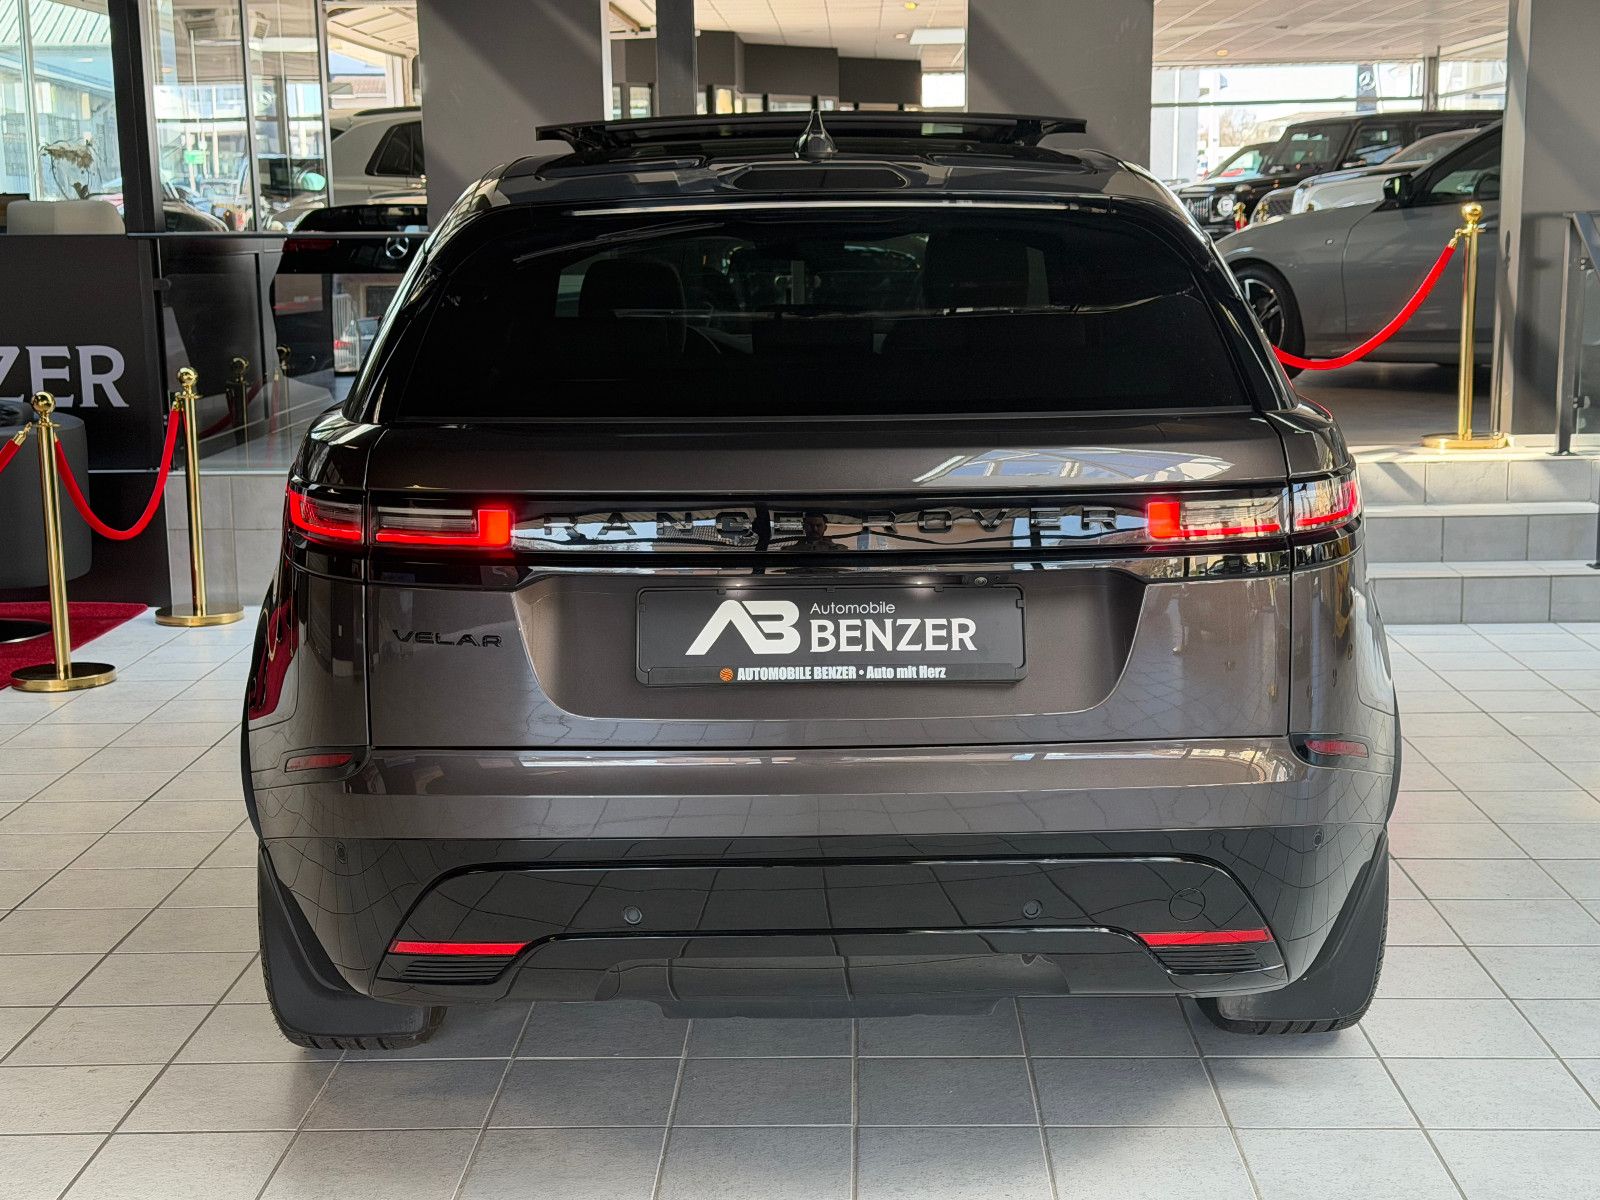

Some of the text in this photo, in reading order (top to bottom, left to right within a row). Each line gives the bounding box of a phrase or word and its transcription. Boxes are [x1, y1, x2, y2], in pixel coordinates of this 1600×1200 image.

[543, 506, 1117, 539] RANGE ROVER
[810, 601, 896, 615] Automobile
[392, 629, 502, 648] VELAR
[809, 618, 978, 653] BENZER
[737, 665, 946, 681] AUTOMOBILE BENZER Auto mit Herz
